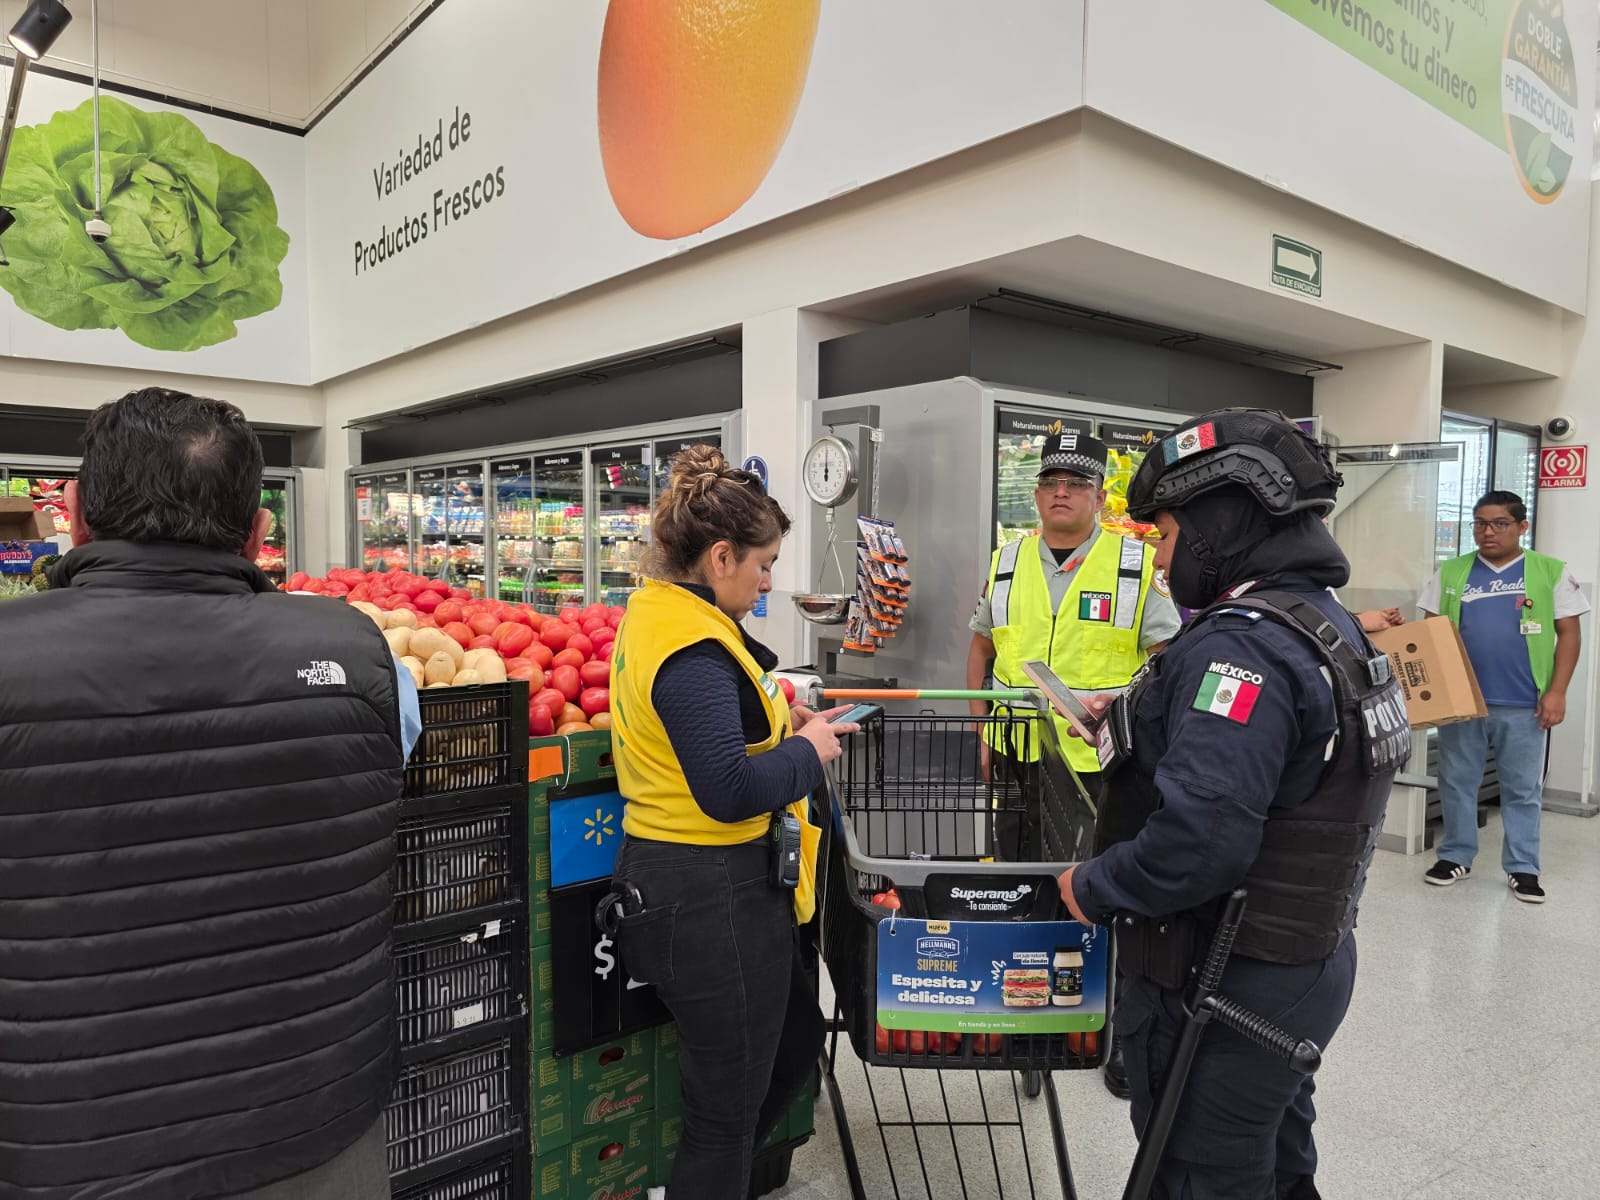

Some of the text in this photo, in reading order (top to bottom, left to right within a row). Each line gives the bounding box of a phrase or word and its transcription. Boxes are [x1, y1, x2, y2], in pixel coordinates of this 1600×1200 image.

[1527, 13, 1561, 59] DOBLE
[1400, 30, 1418, 72] tu
[1424, 46, 1477, 110] dinero
[1514, 32, 1570, 97] GARANTÍA
[1505, 74, 1575, 143] DE FRESCURA
[373, 105, 471, 201] Variedad de
[354, 165, 505, 276] Productos Frescos
[1012, 420, 1081, 436] Naturalmente Express
[1540, 478, 1582, 488] ALARMA
[1461, 583, 1484, 596] Los
[310, 660, 329, 670] THE
[297, 668, 330, 679] NORTH
[307, 676, 331, 686] FACE
[1208, 662, 1263, 685] MÉXICO
[950, 887, 1019, 901] Superama
[970, 901, 1009, 911] Te consiente
[920, 940, 956, 950] HELLMANN'S
[594, 933, 615, 980] $
[917, 958, 958, 973] SUPREME
[891, 973, 983, 993] Espesita y
[897, 989, 976, 1005] deliciosa
